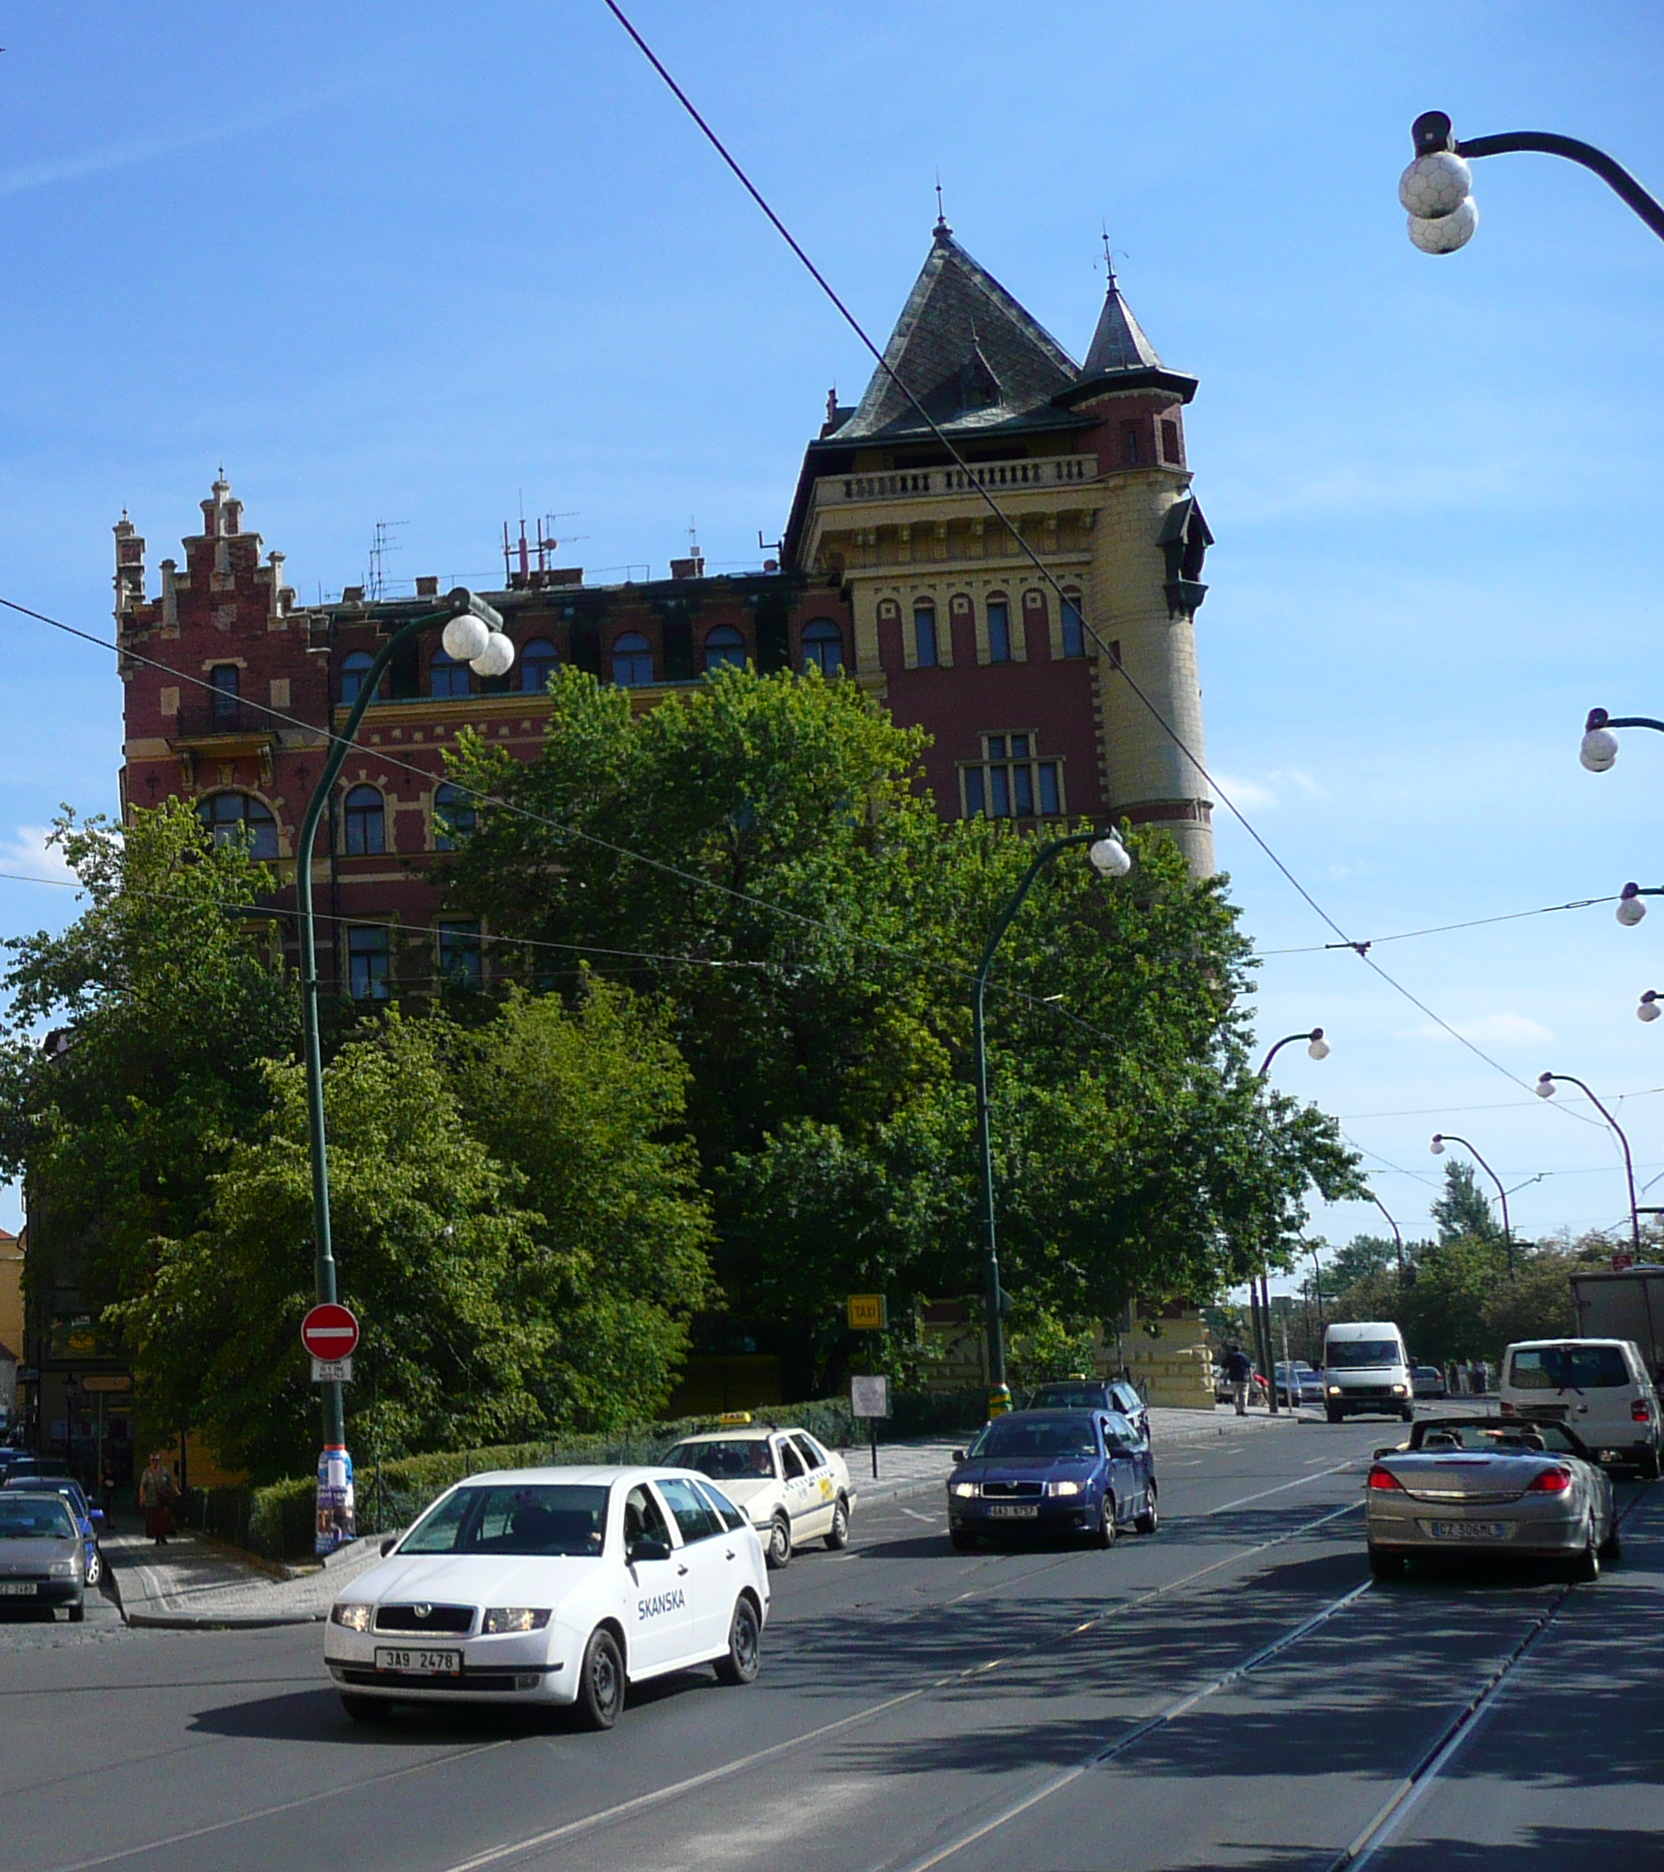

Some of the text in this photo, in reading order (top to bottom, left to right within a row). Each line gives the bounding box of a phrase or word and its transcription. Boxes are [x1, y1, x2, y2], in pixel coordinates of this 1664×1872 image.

[854, 1305, 877, 1318] TAXI
[638, 1588, 686, 1621] SKANSKA
[387, 1652, 453, 1669] 3A9 2478
